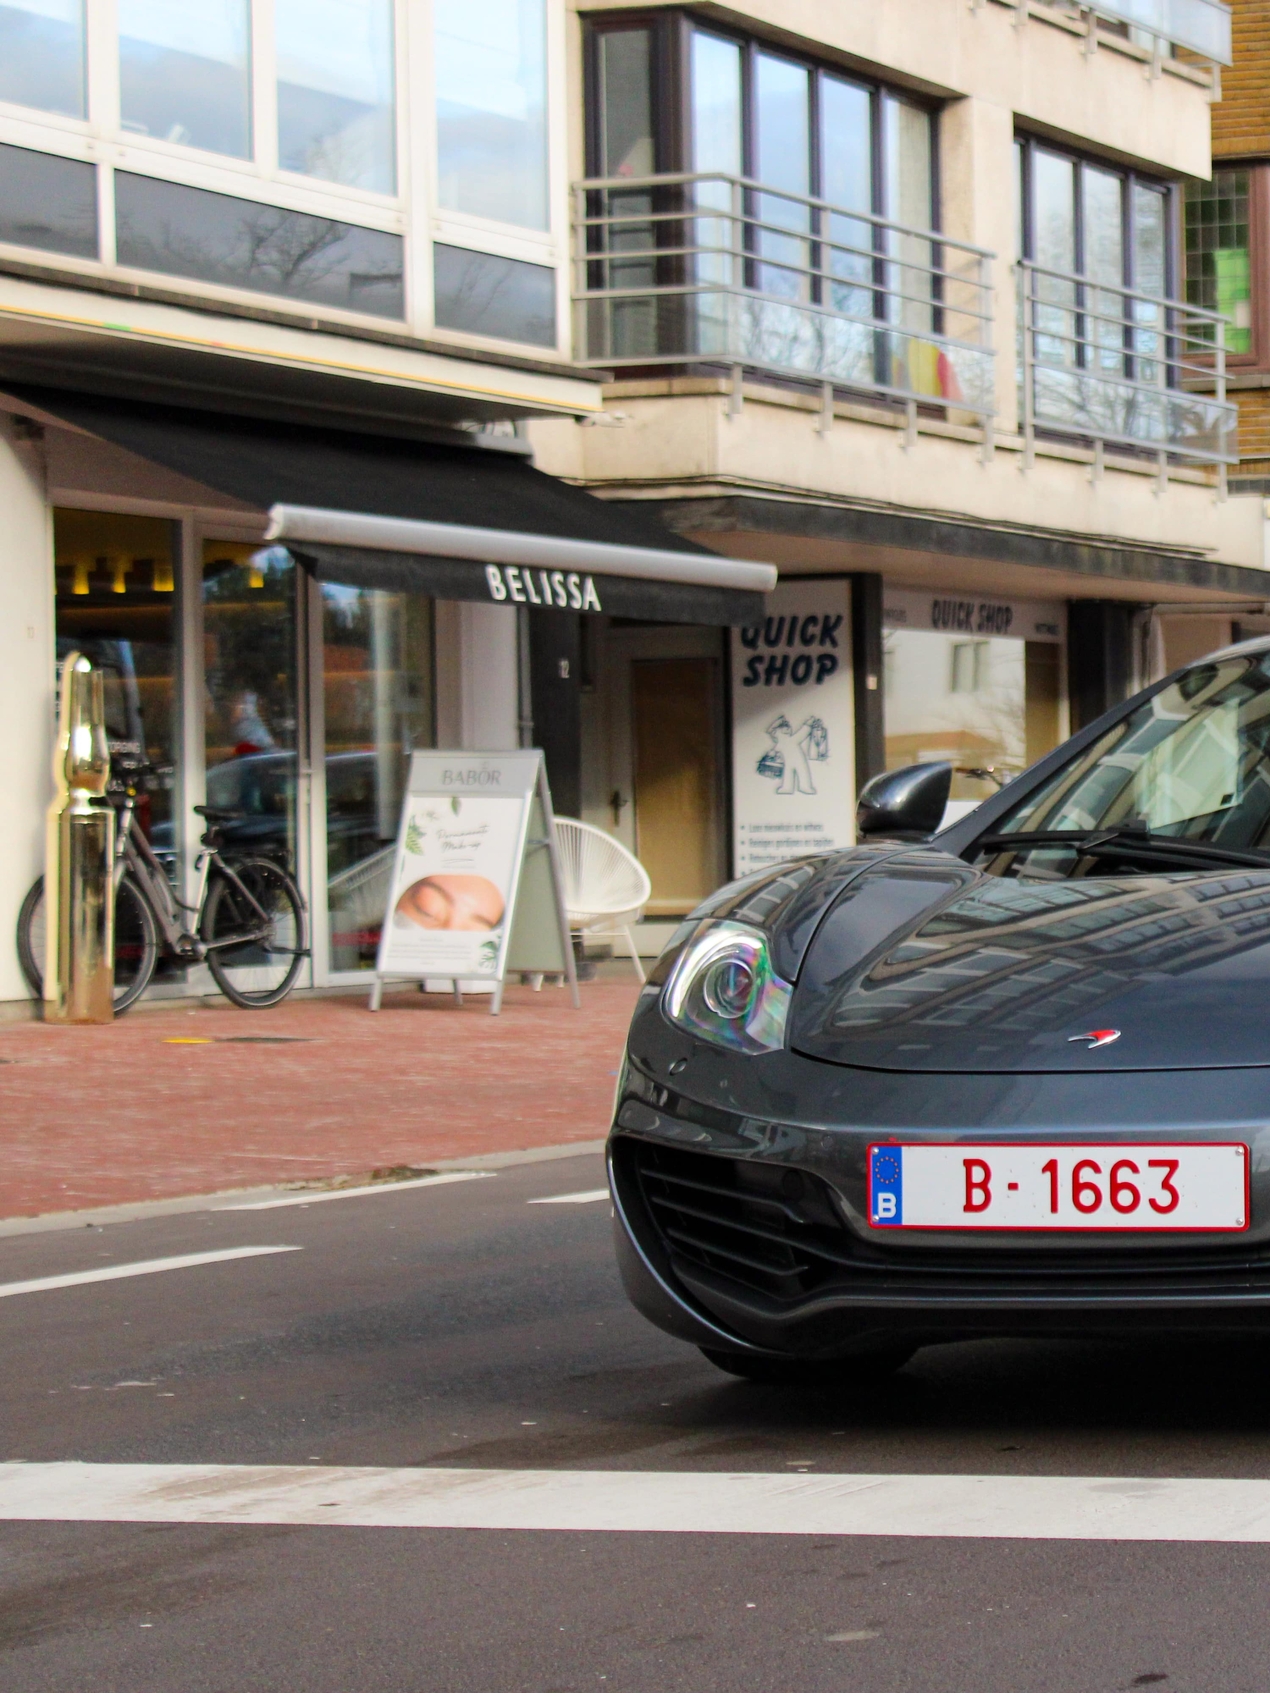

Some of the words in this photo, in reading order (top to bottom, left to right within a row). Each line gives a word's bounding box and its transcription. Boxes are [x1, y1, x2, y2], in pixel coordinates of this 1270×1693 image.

[484, 563, 602, 612] BELISSA
[741, 614, 844, 650] QUICK
[931, 599, 975, 634] QUICK
[977, 602, 1014, 635] SHOP
[743, 653, 838, 687] SHOP
[877, 1192, 897, 1218] B
